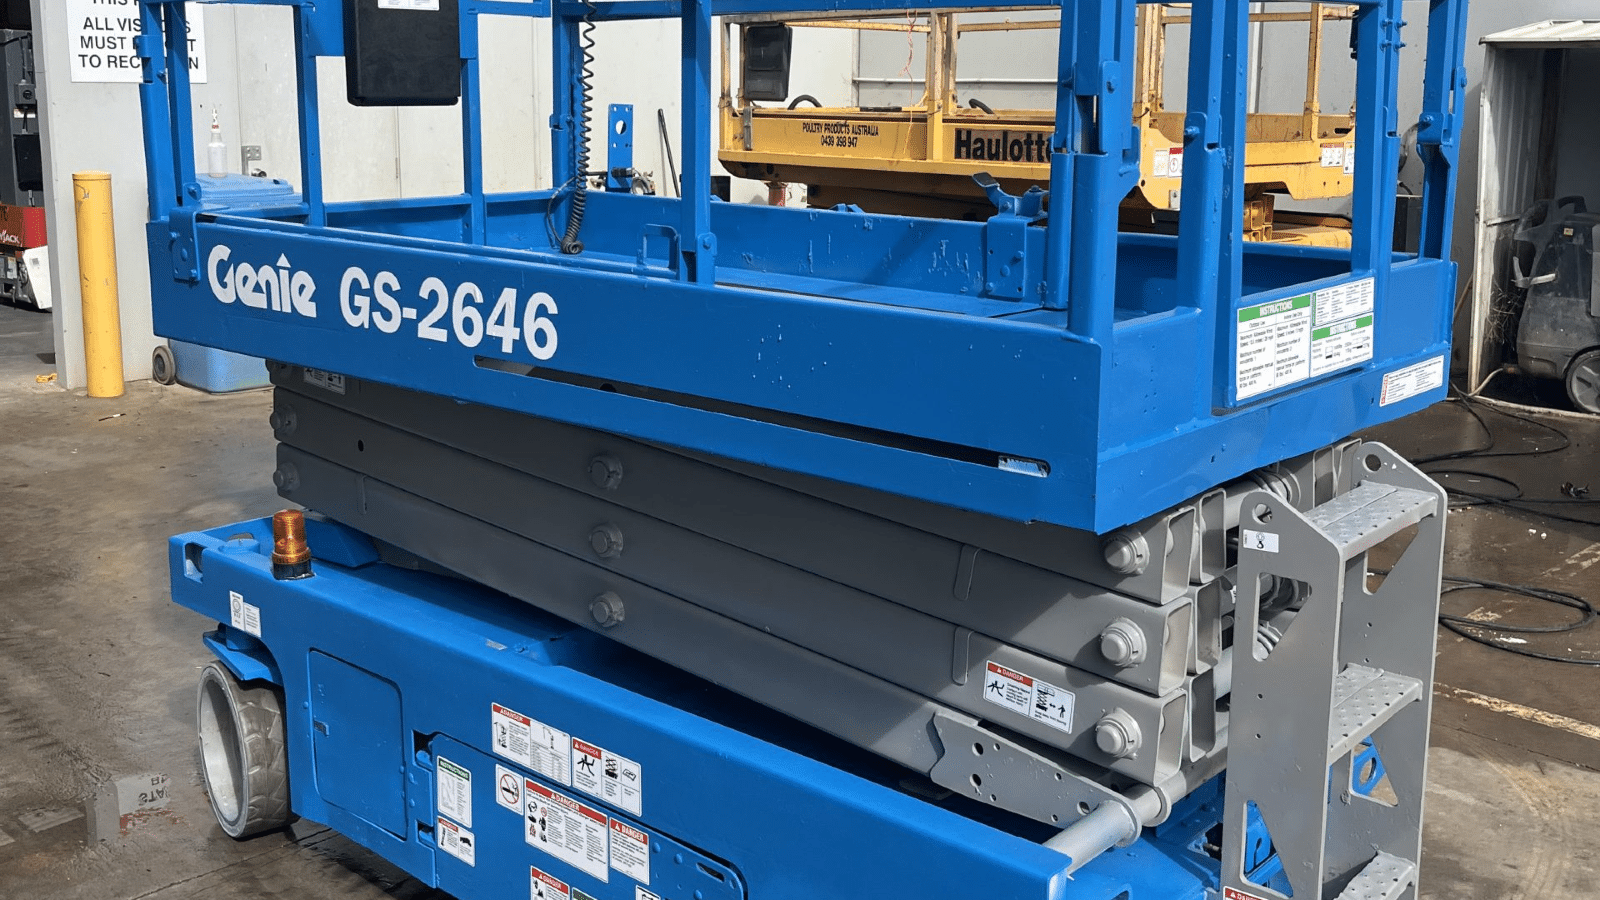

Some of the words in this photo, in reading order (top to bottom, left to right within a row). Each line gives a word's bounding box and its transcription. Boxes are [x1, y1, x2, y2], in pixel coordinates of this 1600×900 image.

[83, 17, 114, 31] ALL
[117, 18, 191, 34] VISS
[80, 36, 127, 50] MUST
[78, 54, 102, 69] TO
[802, 122, 823, 133] POULTRY
[824, 123, 850, 134] PRODUCTS
[852, 124, 879, 136] AUSTRALIA
[821, 135, 834, 147] 0439
[847, 136, 858, 147] 947
[206, 244, 317, 318] Genie
[340, 266, 558, 360] GS-2646
[621, 825, 644, 842] DANGER
